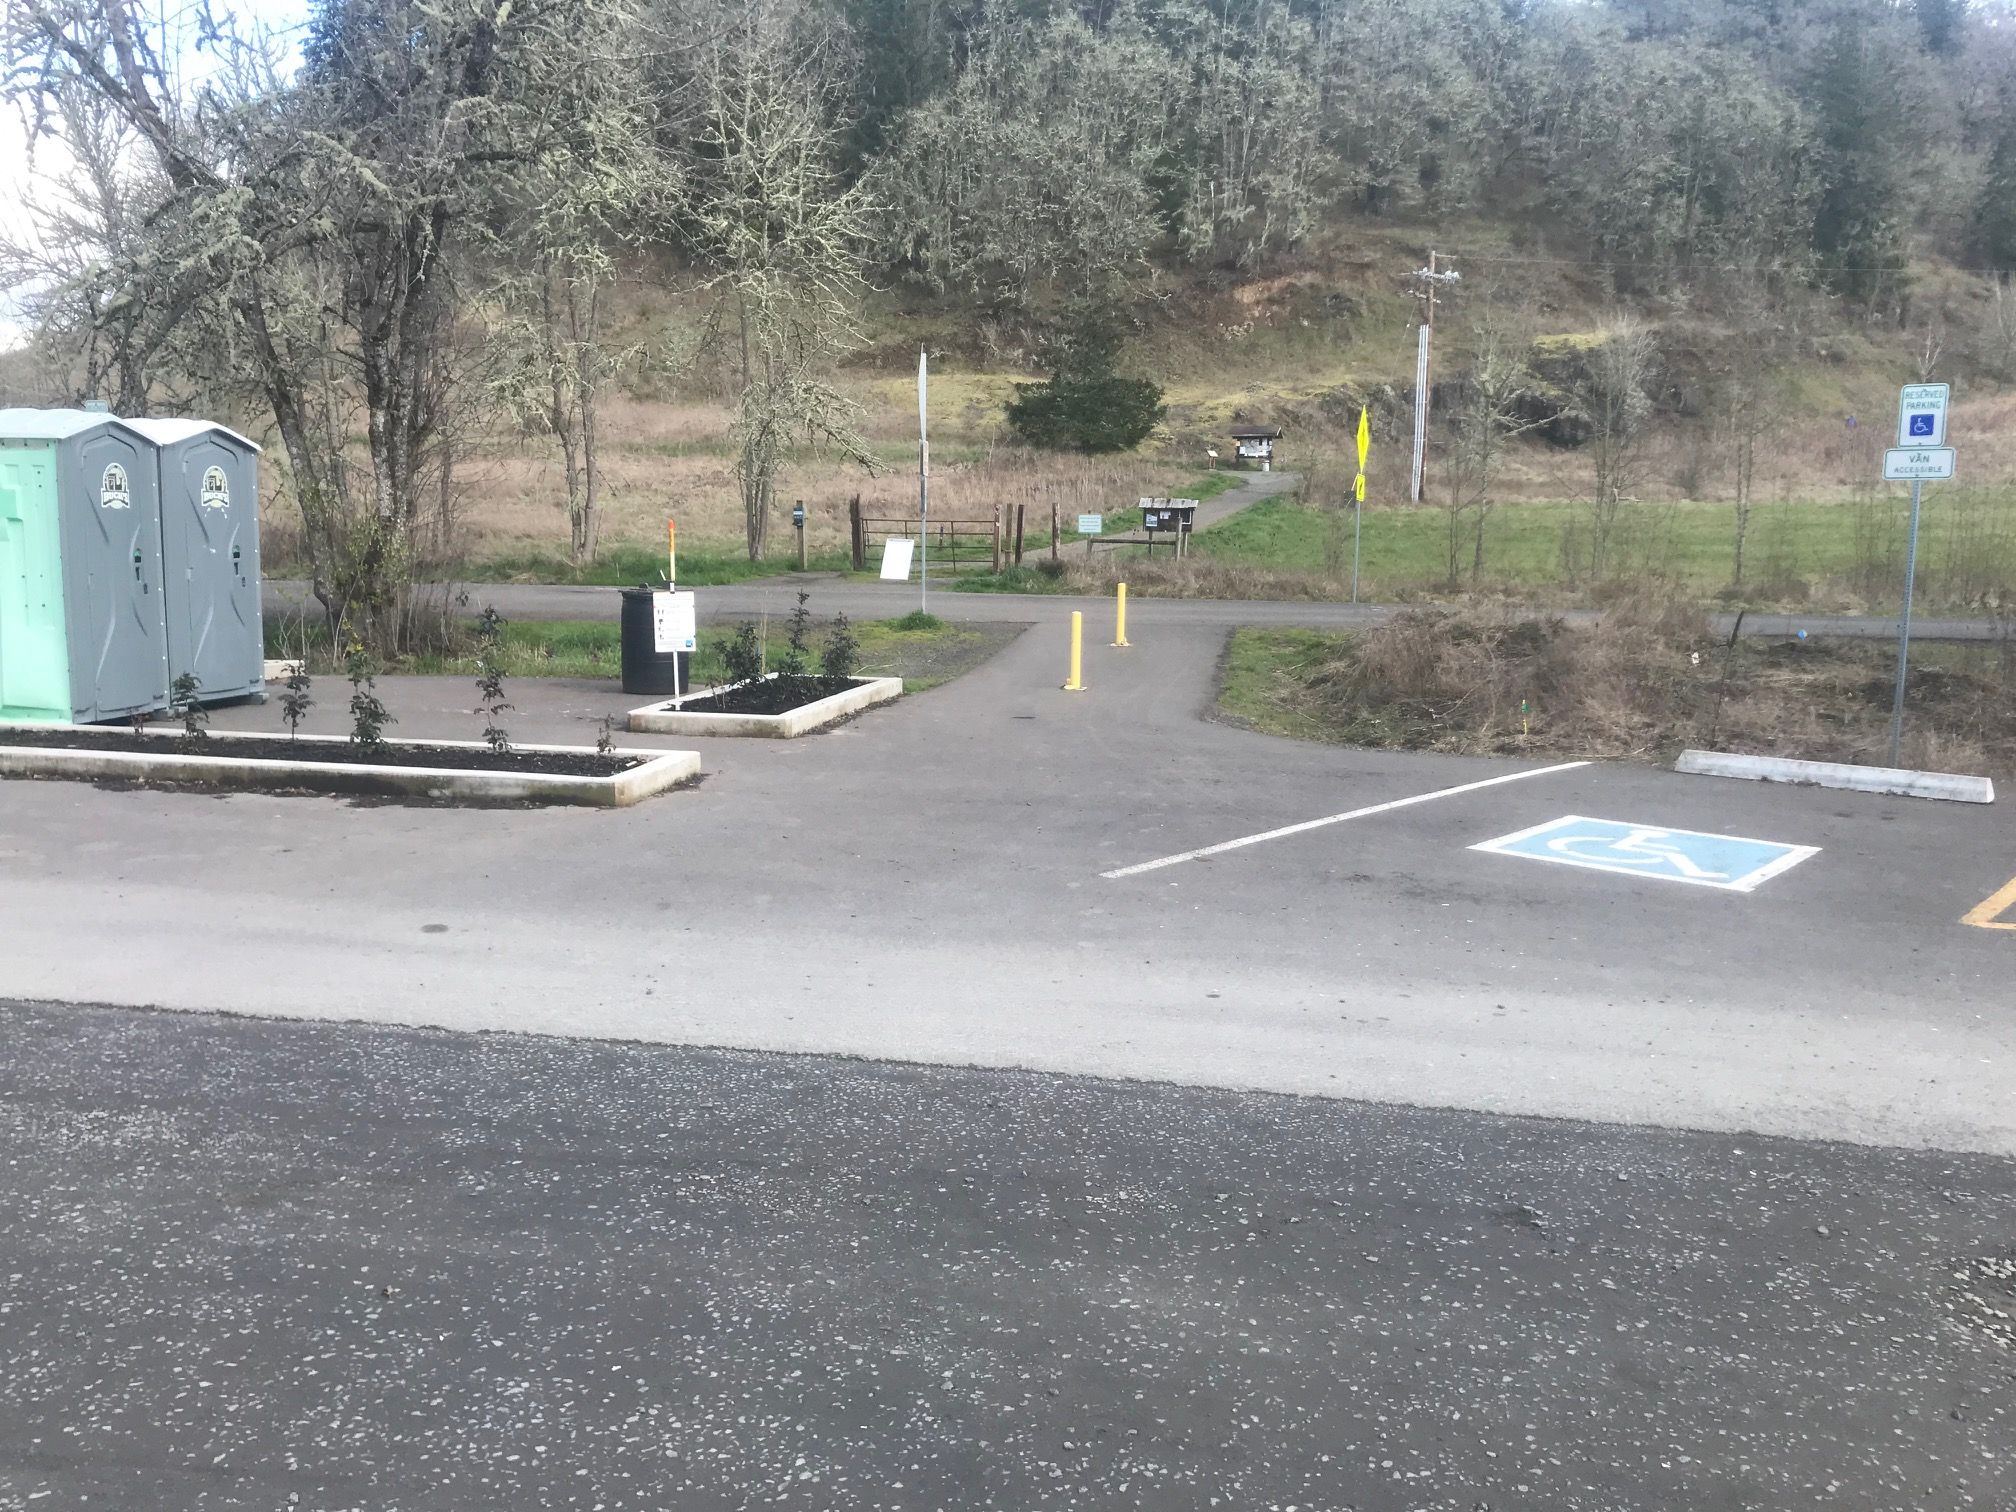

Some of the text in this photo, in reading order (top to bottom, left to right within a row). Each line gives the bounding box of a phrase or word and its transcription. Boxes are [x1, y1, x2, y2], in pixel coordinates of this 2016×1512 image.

[1905, 390, 1944, 399] RESERVED
[1906, 401, 1941, 409] PARKING
[1909, 455, 1930, 463] VAN
